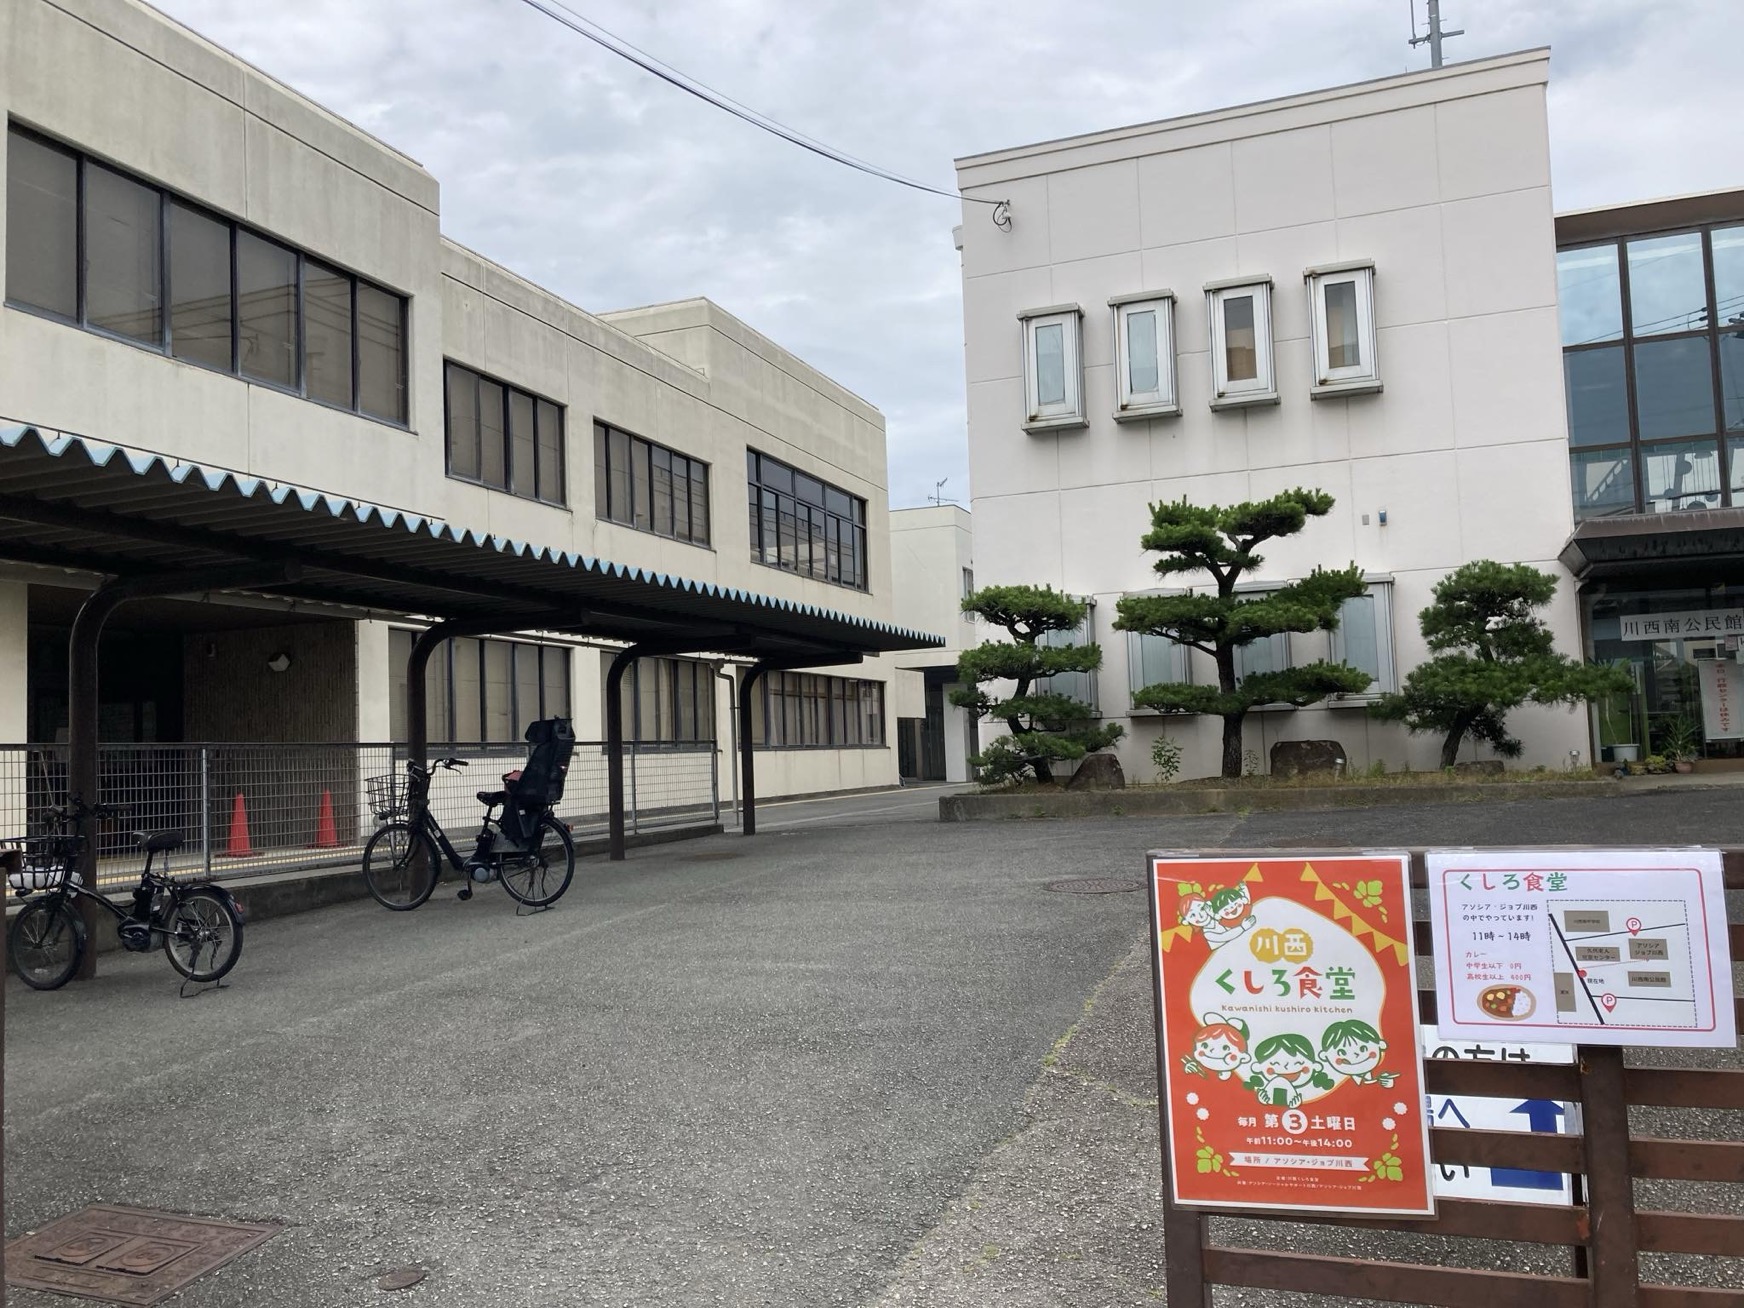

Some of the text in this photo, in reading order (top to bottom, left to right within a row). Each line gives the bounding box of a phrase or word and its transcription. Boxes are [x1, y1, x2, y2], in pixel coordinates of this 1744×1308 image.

[1623, 614, 1742, 636] 川西南公民館
[1460, 872, 1568, 892] くしろ食堂
[1256, 934, 1307, 956] 川西
[1215, 966, 1356, 1000] くしろ食堂
[1221, 1004, 1353, 1014] Kawanishi kushiro kitchen
[1237, 1116, 1257, 1127] 毎月
